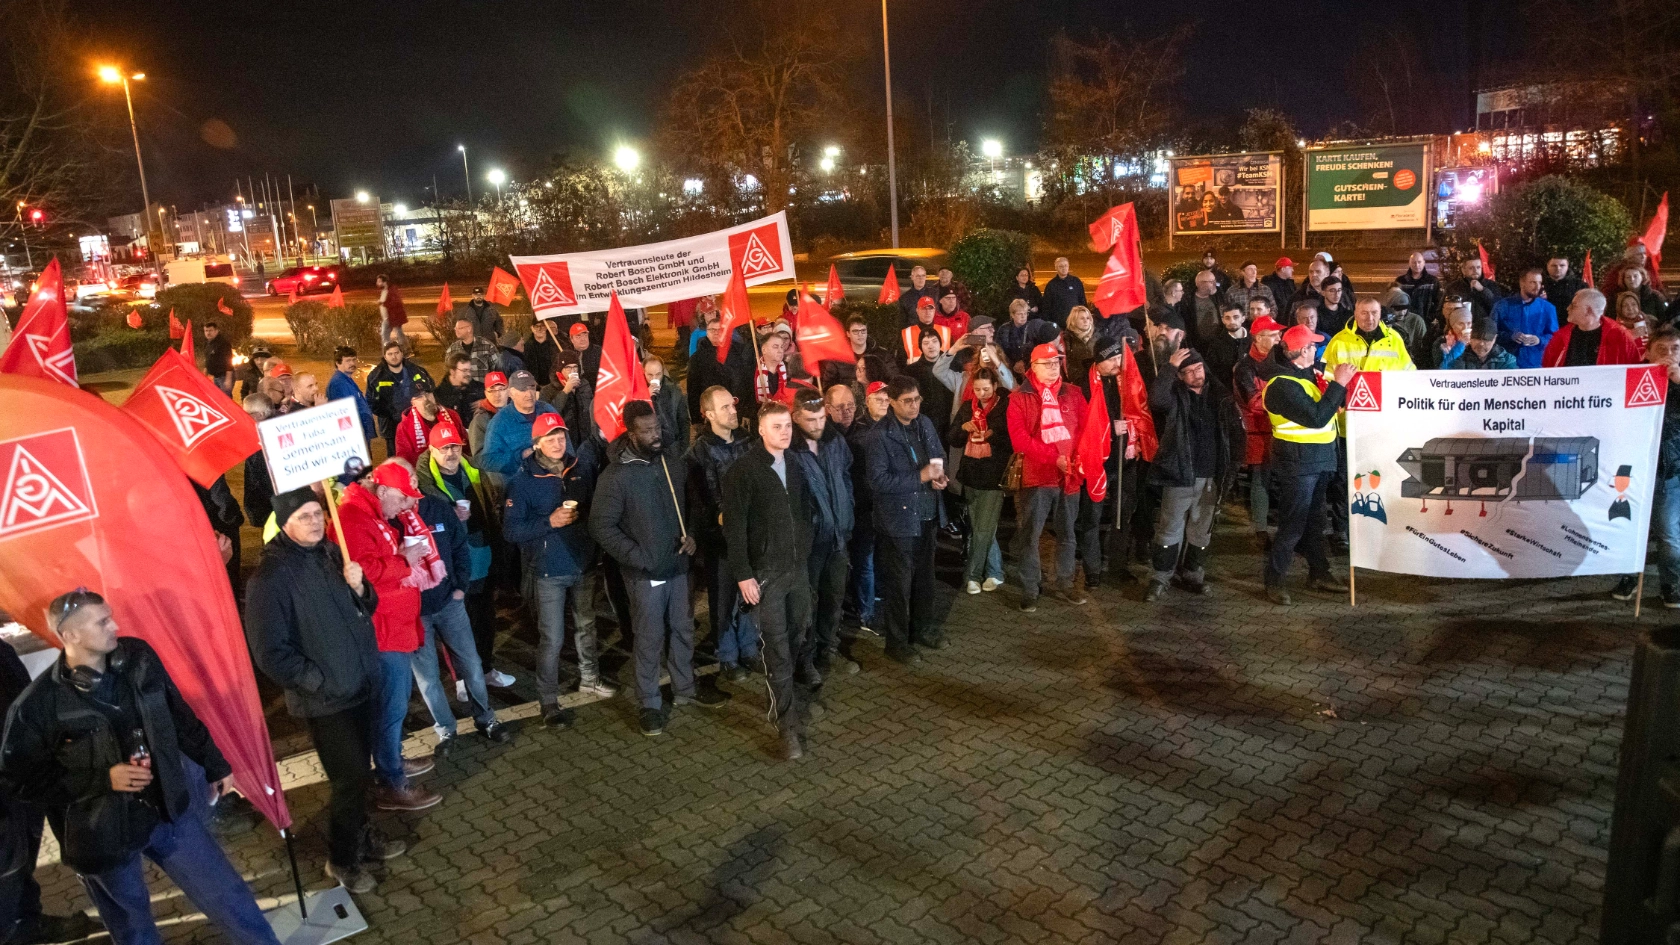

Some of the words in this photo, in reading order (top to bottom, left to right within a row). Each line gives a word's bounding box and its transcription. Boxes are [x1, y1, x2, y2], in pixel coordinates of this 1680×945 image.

[1316, 163, 1346, 171] FREUDE
[1347, 161, 1393, 170] SCHENKEN!
[1343, 153, 1378, 161] KAUFEN,
[1334, 183, 1388, 192] GUTSCHEIN-
[1334, 193, 1365, 202] KARTE!
[596, 266, 626, 280] Robert
[628, 265, 656, 277] Bosch
[658, 259, 685, 271] GmbH
[687, 255, 705, 265] und
[605, 252, 674, 269] Vertrauensleute
[676, 250, 692, 258] der
[584, 281, 614, 291] Robert
[616, 277, 644, 288] Bosch
[646, 268, 689, 282] Elektronik
[692, 262, 720, 274] GmbH
[683, 268, 732, 283] Hildesheim
[1430, 377, 1498, 389] Vertrauensleute
[1501, 376, 1541, 387] JENSEN
[1544, 376, 1580, 386] Harsum
[1398, 397, 1435, 411] Politik
[1438, 398, 1455, 411] für
[1458, 398, 1480, 411] den
[1484, 398, 1546, 411] Menschen
[1554, 396, 1585, 410] nicht
[1588, 396, 1612, 409] fürs
[276, 408, 348, 432] Vertrauensleute
[1483, 418, 1525, 434] Kapital
[284, 460, 309, 476] Sind
[312, 456, 328, 467] wir
[1405, 525, 1466, 564] #FürEinGutesLeben
[1460, 528, 1514, 560] #SichereZukunft
[1505, 528, 1562, 559] #StarkeWirtschaft
[1564, 534, 1599, 555] Miteinander
